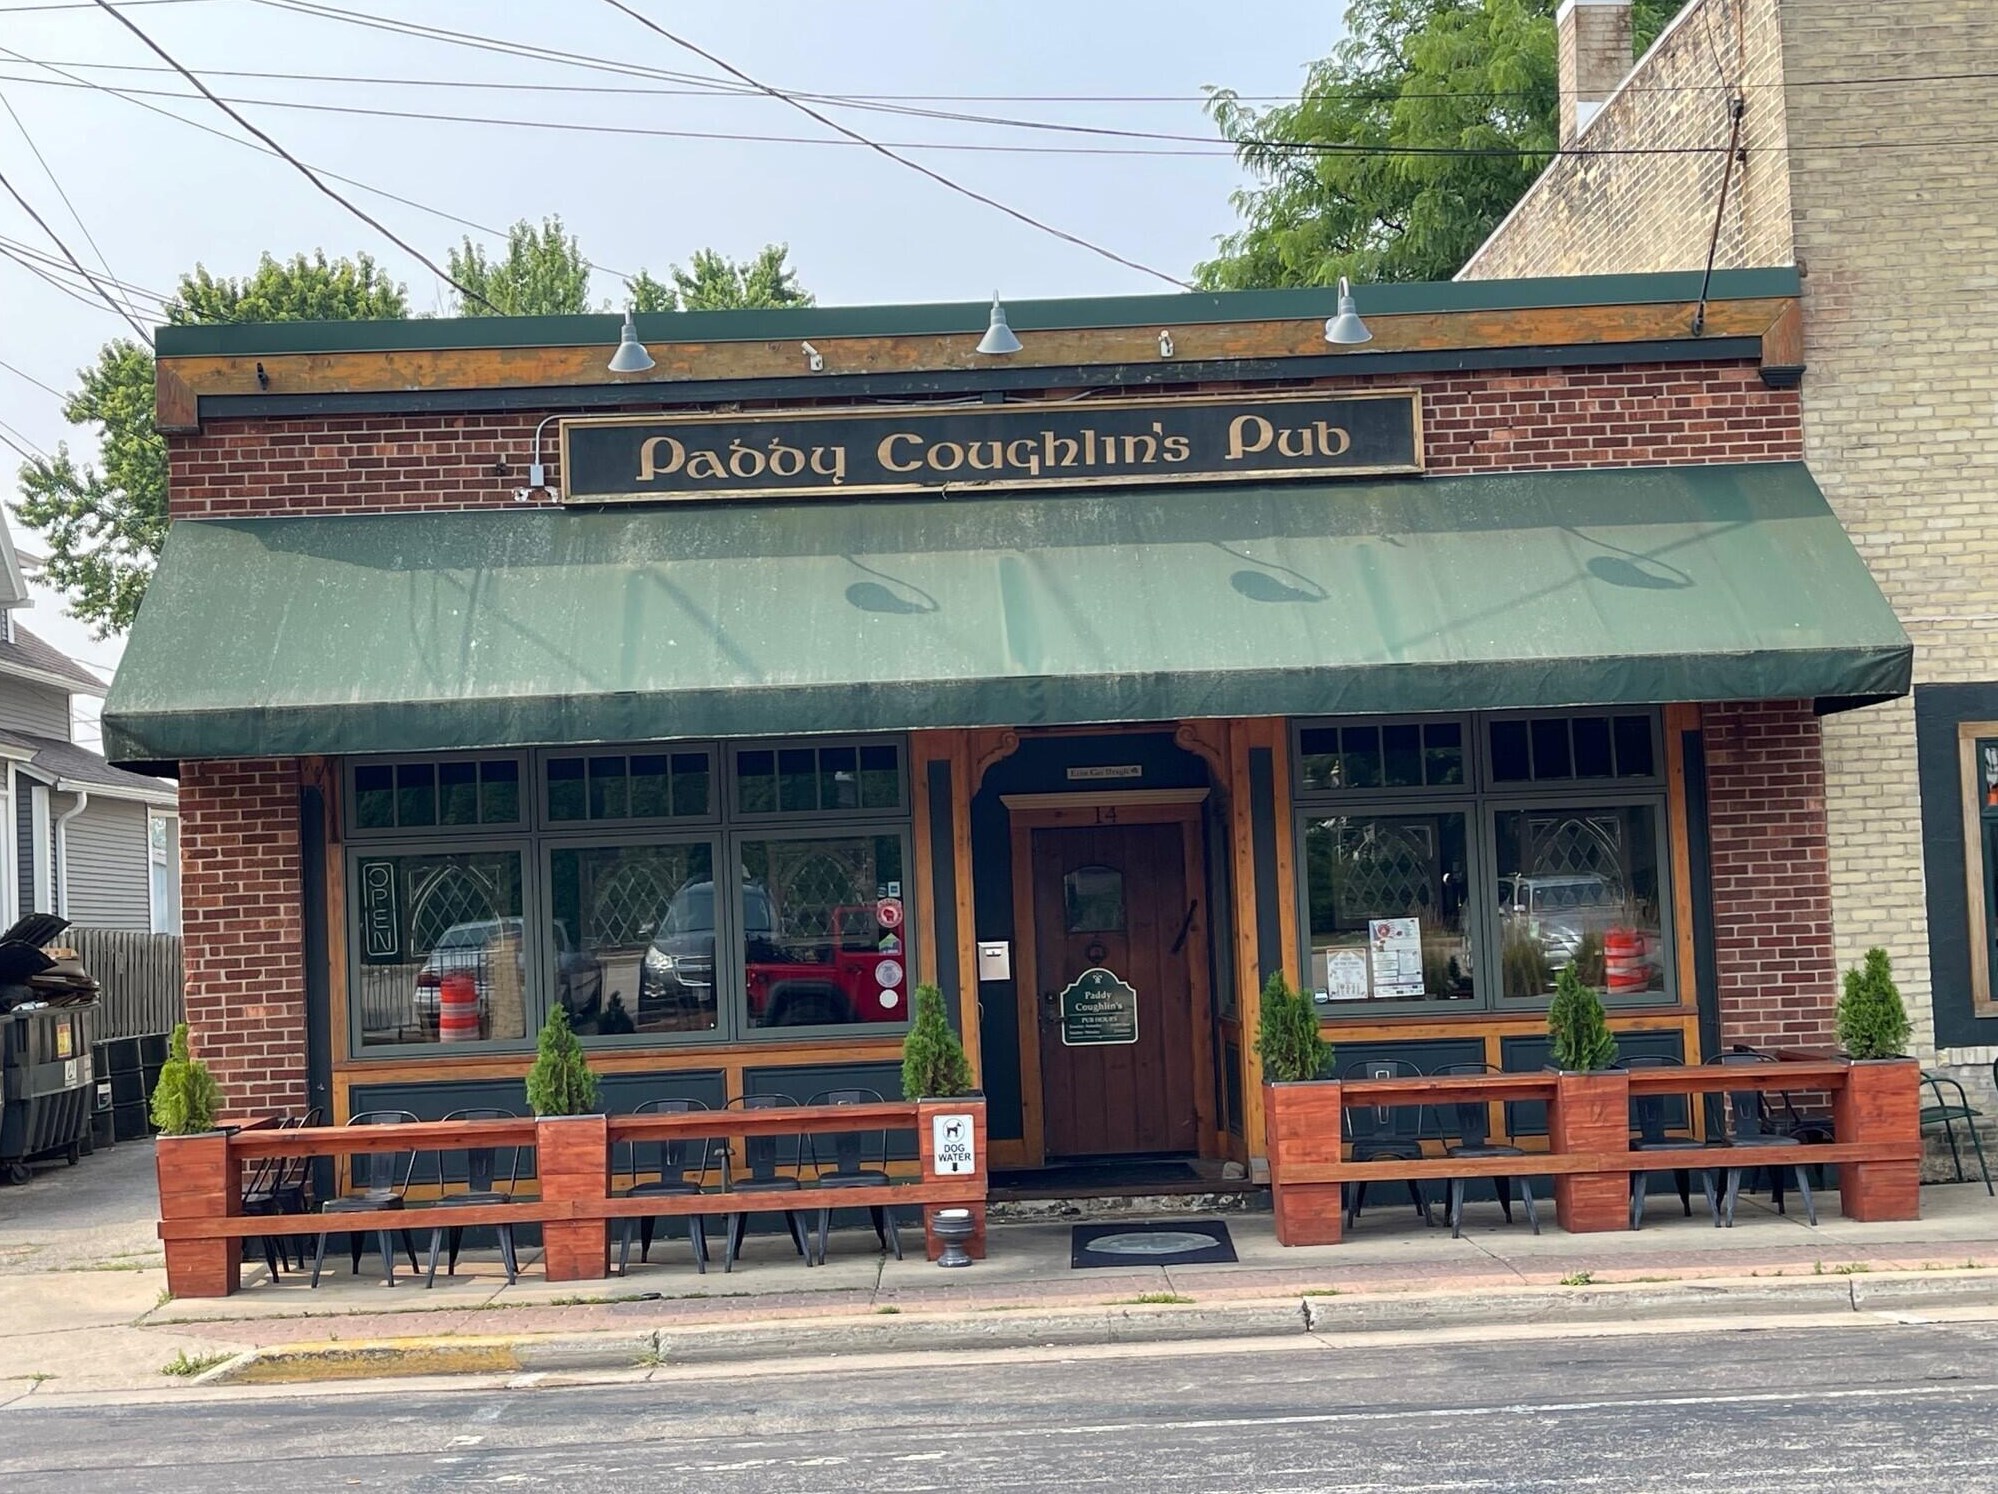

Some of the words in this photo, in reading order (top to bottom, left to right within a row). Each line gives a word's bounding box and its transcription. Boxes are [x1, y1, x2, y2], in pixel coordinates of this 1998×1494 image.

[635, 434, 847, 486] Paddy
[877, 422, 1190, 476] Coughlin's
[1225, 414, 1352, 460] Pub
[1095, 806, 1117, 824] 14
[368, 867, 392, 951] OPEN
[1084, 990, 1113, 1001] Paddy
[1075, 1001, 1123, 1013] Coughlin's
[944, 1143, 966, 1153] DOG
[938, 1152, 972, 1162] WATER
